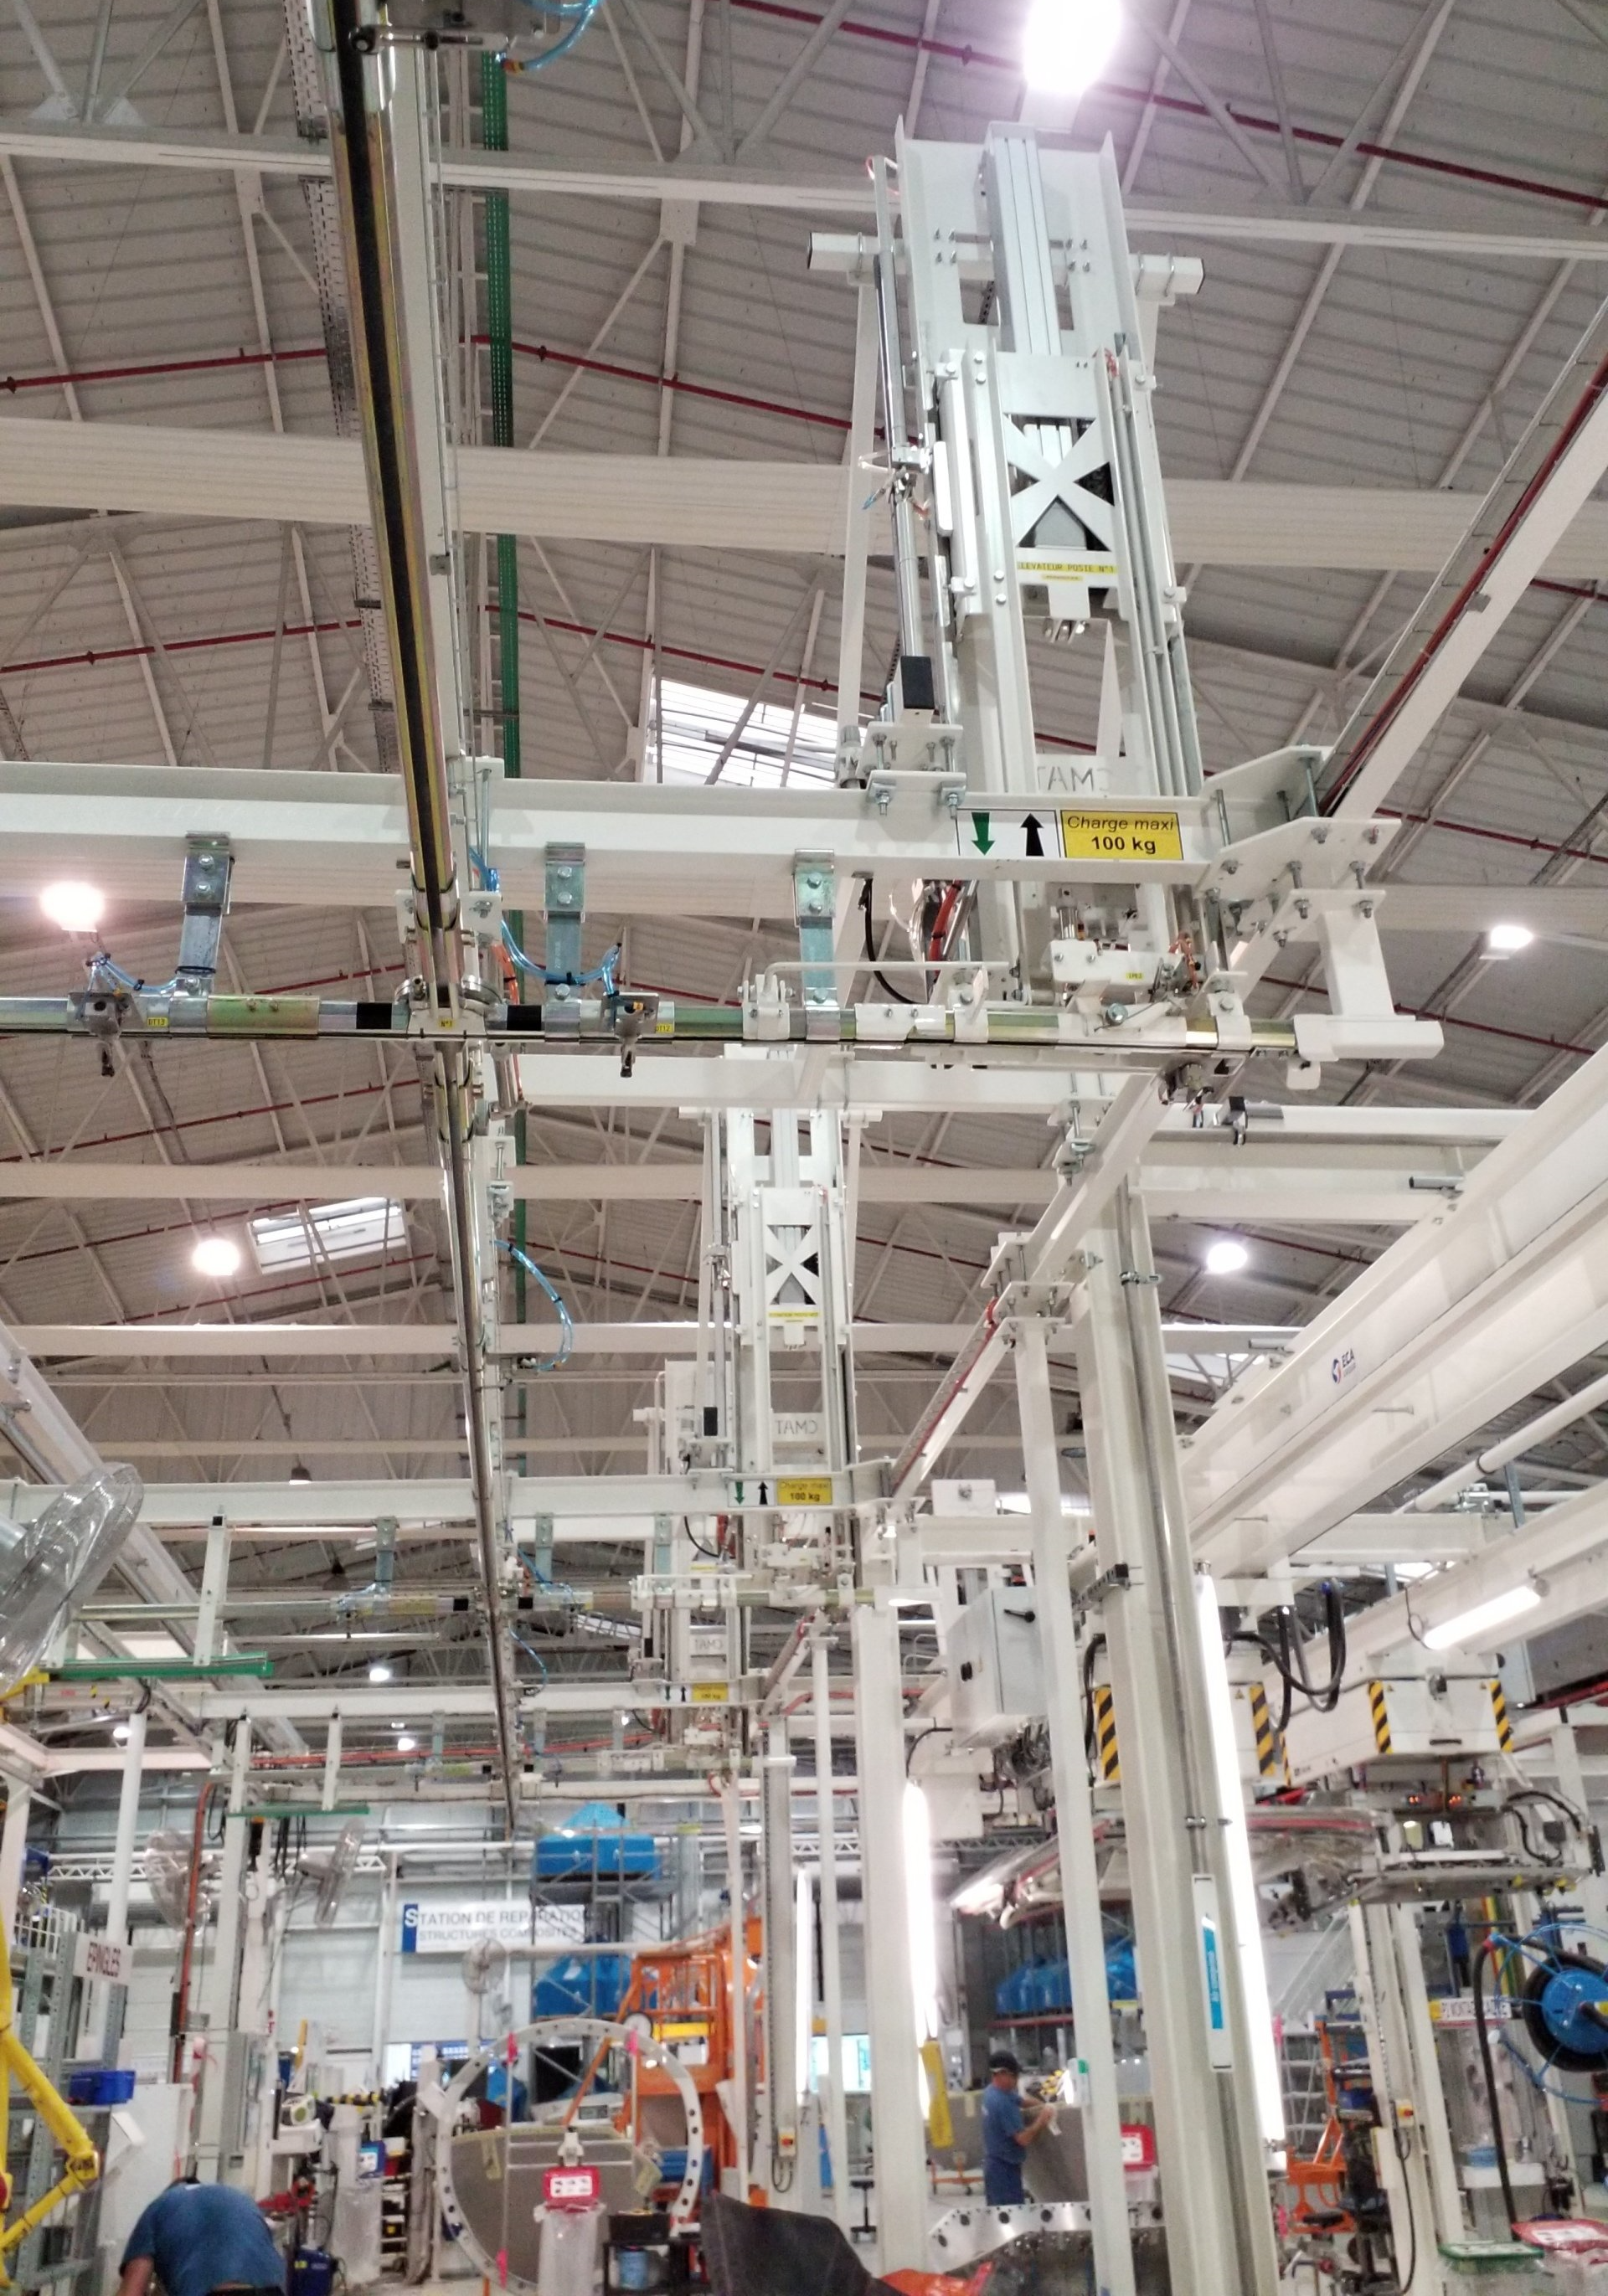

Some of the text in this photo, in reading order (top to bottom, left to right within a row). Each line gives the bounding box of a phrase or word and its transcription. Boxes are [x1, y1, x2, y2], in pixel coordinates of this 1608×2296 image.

[1067, 816, 1173, 832] Charge maxi
[1091, 836, 1156, 855] 100 kg
[791, 1492, 821, 1502] 100 kg
[405, 1907, 472, 1928] STATION
[476, 1911, 496, 1924] DE
